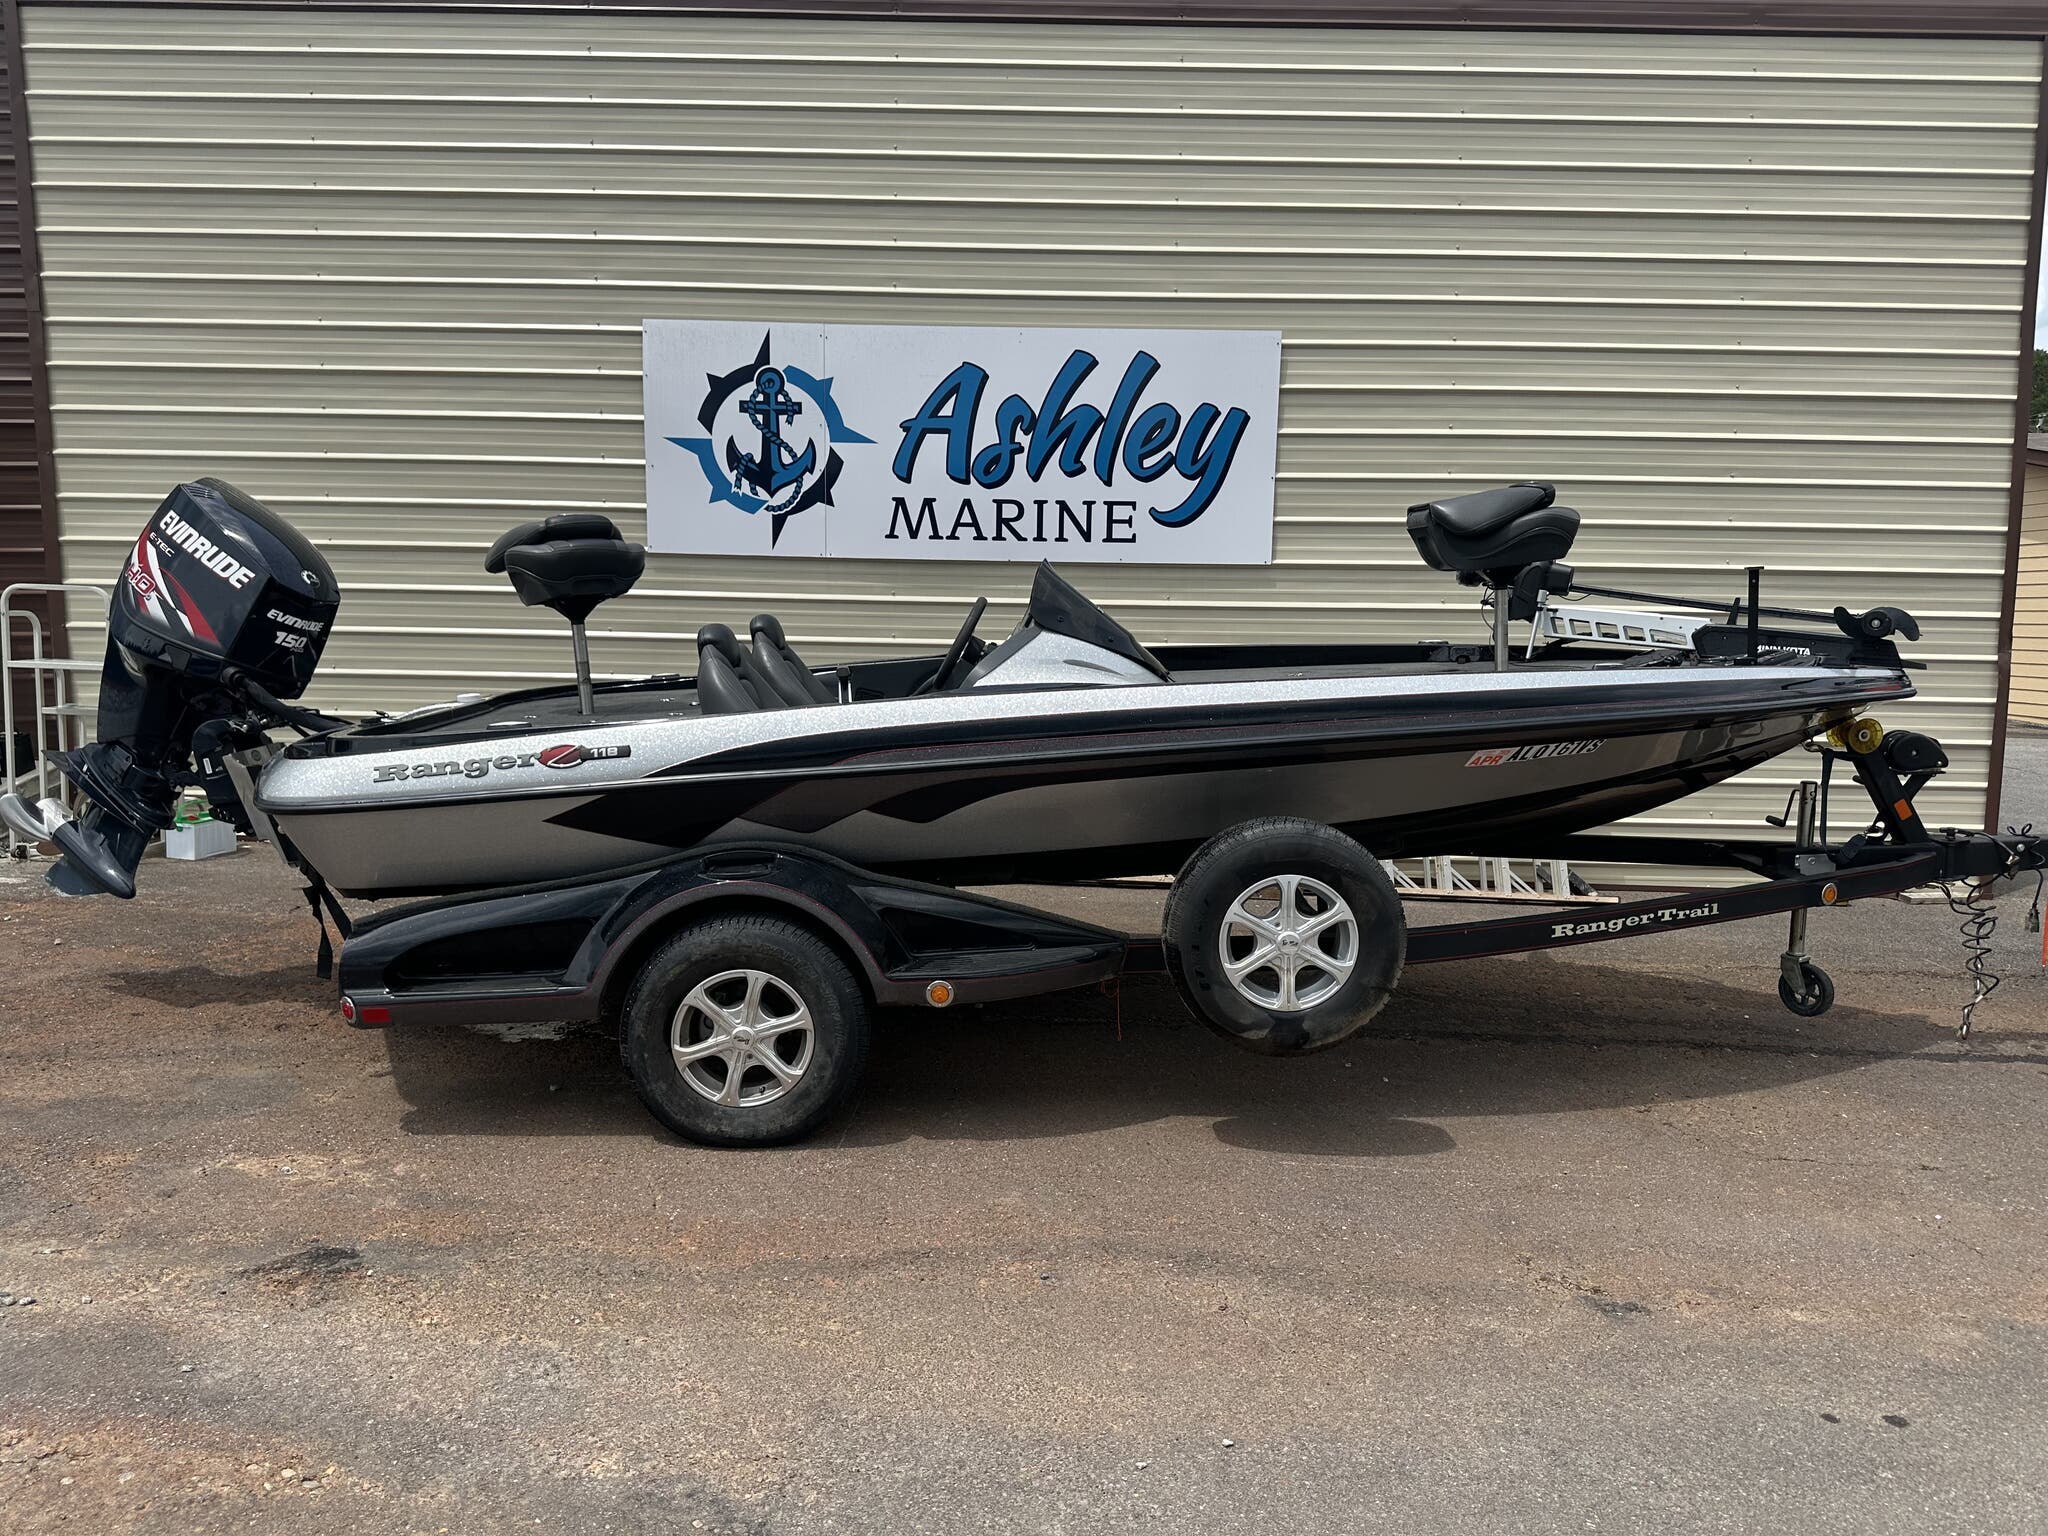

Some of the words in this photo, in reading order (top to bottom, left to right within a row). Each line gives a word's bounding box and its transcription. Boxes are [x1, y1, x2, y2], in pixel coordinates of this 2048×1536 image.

[892, 349, 1251, 528] Ashley
[885, 497, 1137, 543] MARINE
[149, 531, 175, 558] E-TEC
[159, 510, 256, 589] EVINRUDE
[266, 608, 325, 632] EVINRUDE
[274, 631, 308, 648] 150
[373, 751, 541, 783] Ranger
[590, 746, 618, 758] 118
[1471, 755, 1503, 766] APR
[1551, 913, 1655, 938] Ranger
[1657, 903, 1720, 922] Trail
